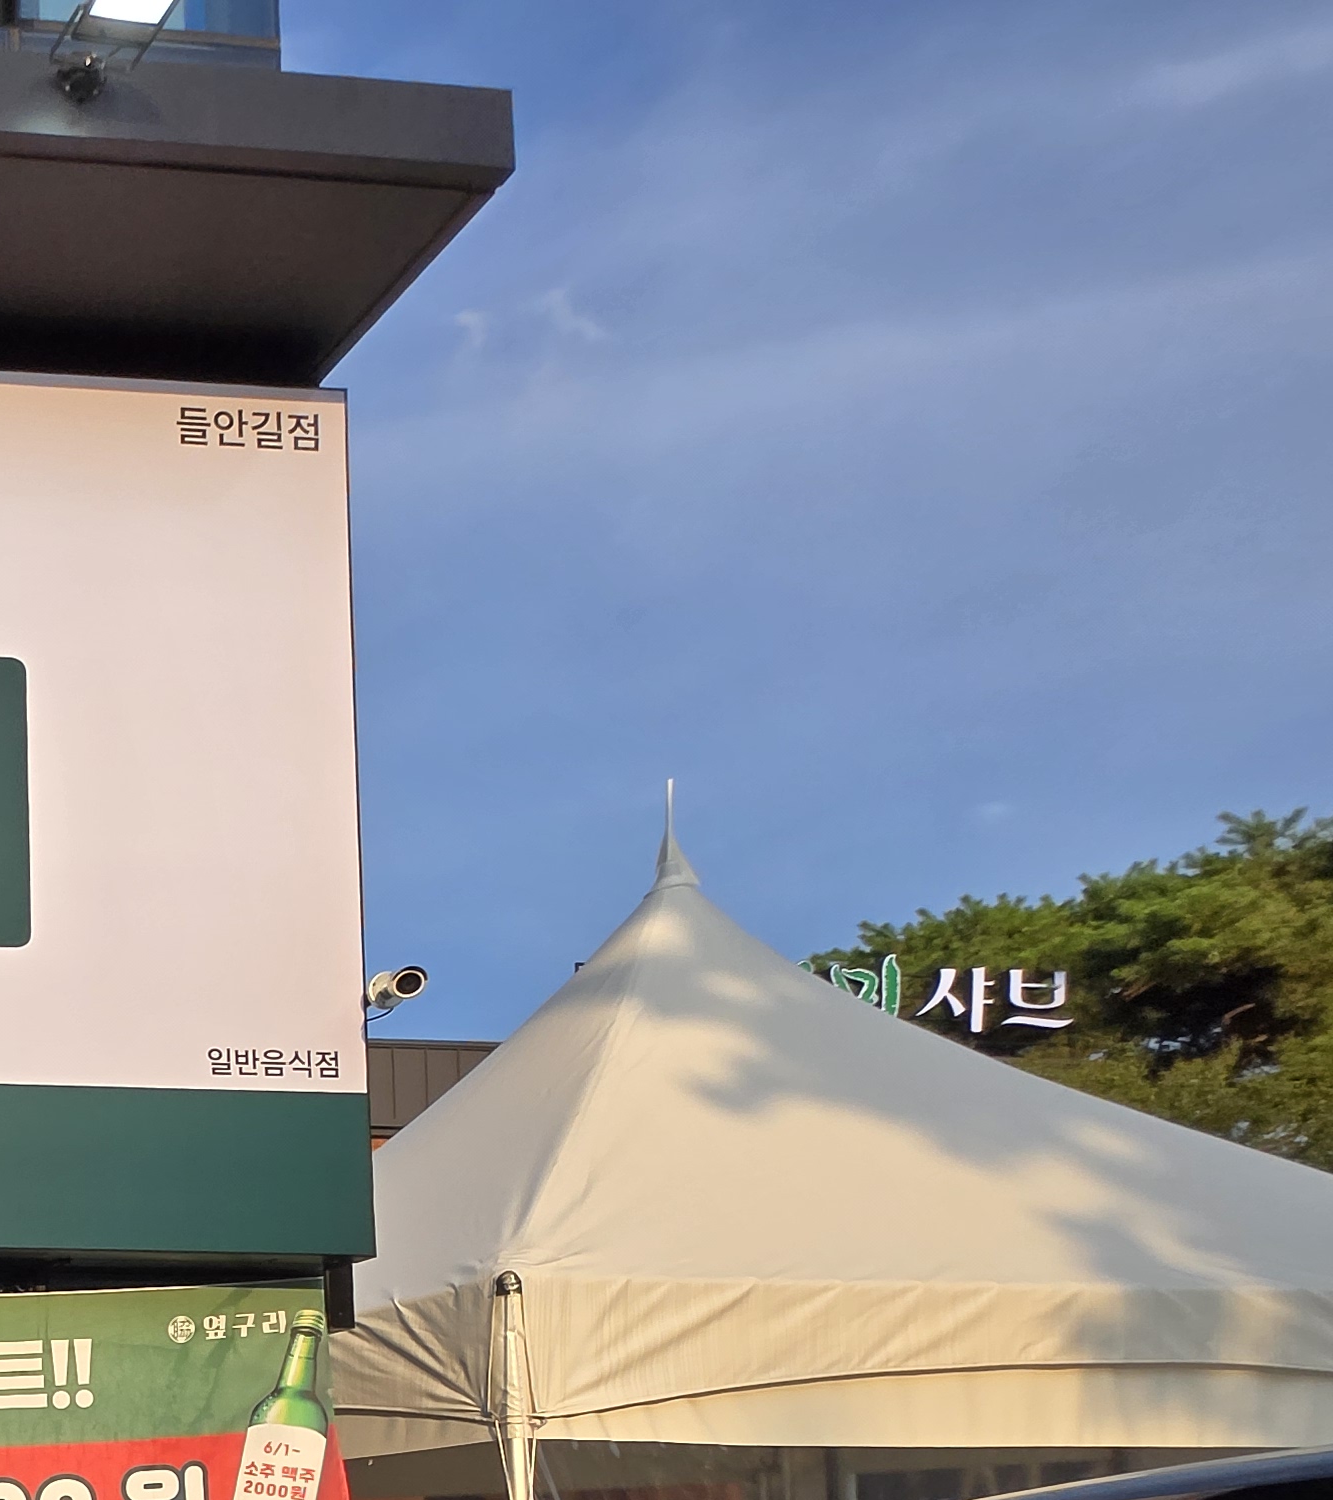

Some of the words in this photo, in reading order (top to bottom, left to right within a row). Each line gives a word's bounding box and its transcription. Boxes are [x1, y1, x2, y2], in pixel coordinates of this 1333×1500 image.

[176, 406, 320, 452] 들안길점
[915, 966, 1075, 1033] 샤브
[207, 1047, 341, 1079] 일반음식점
[203, 1310, 287, 1341] 옆구리
[244, 1461, 276, 1479] 소주
[281, 1466, 316, 1484] 맥주
